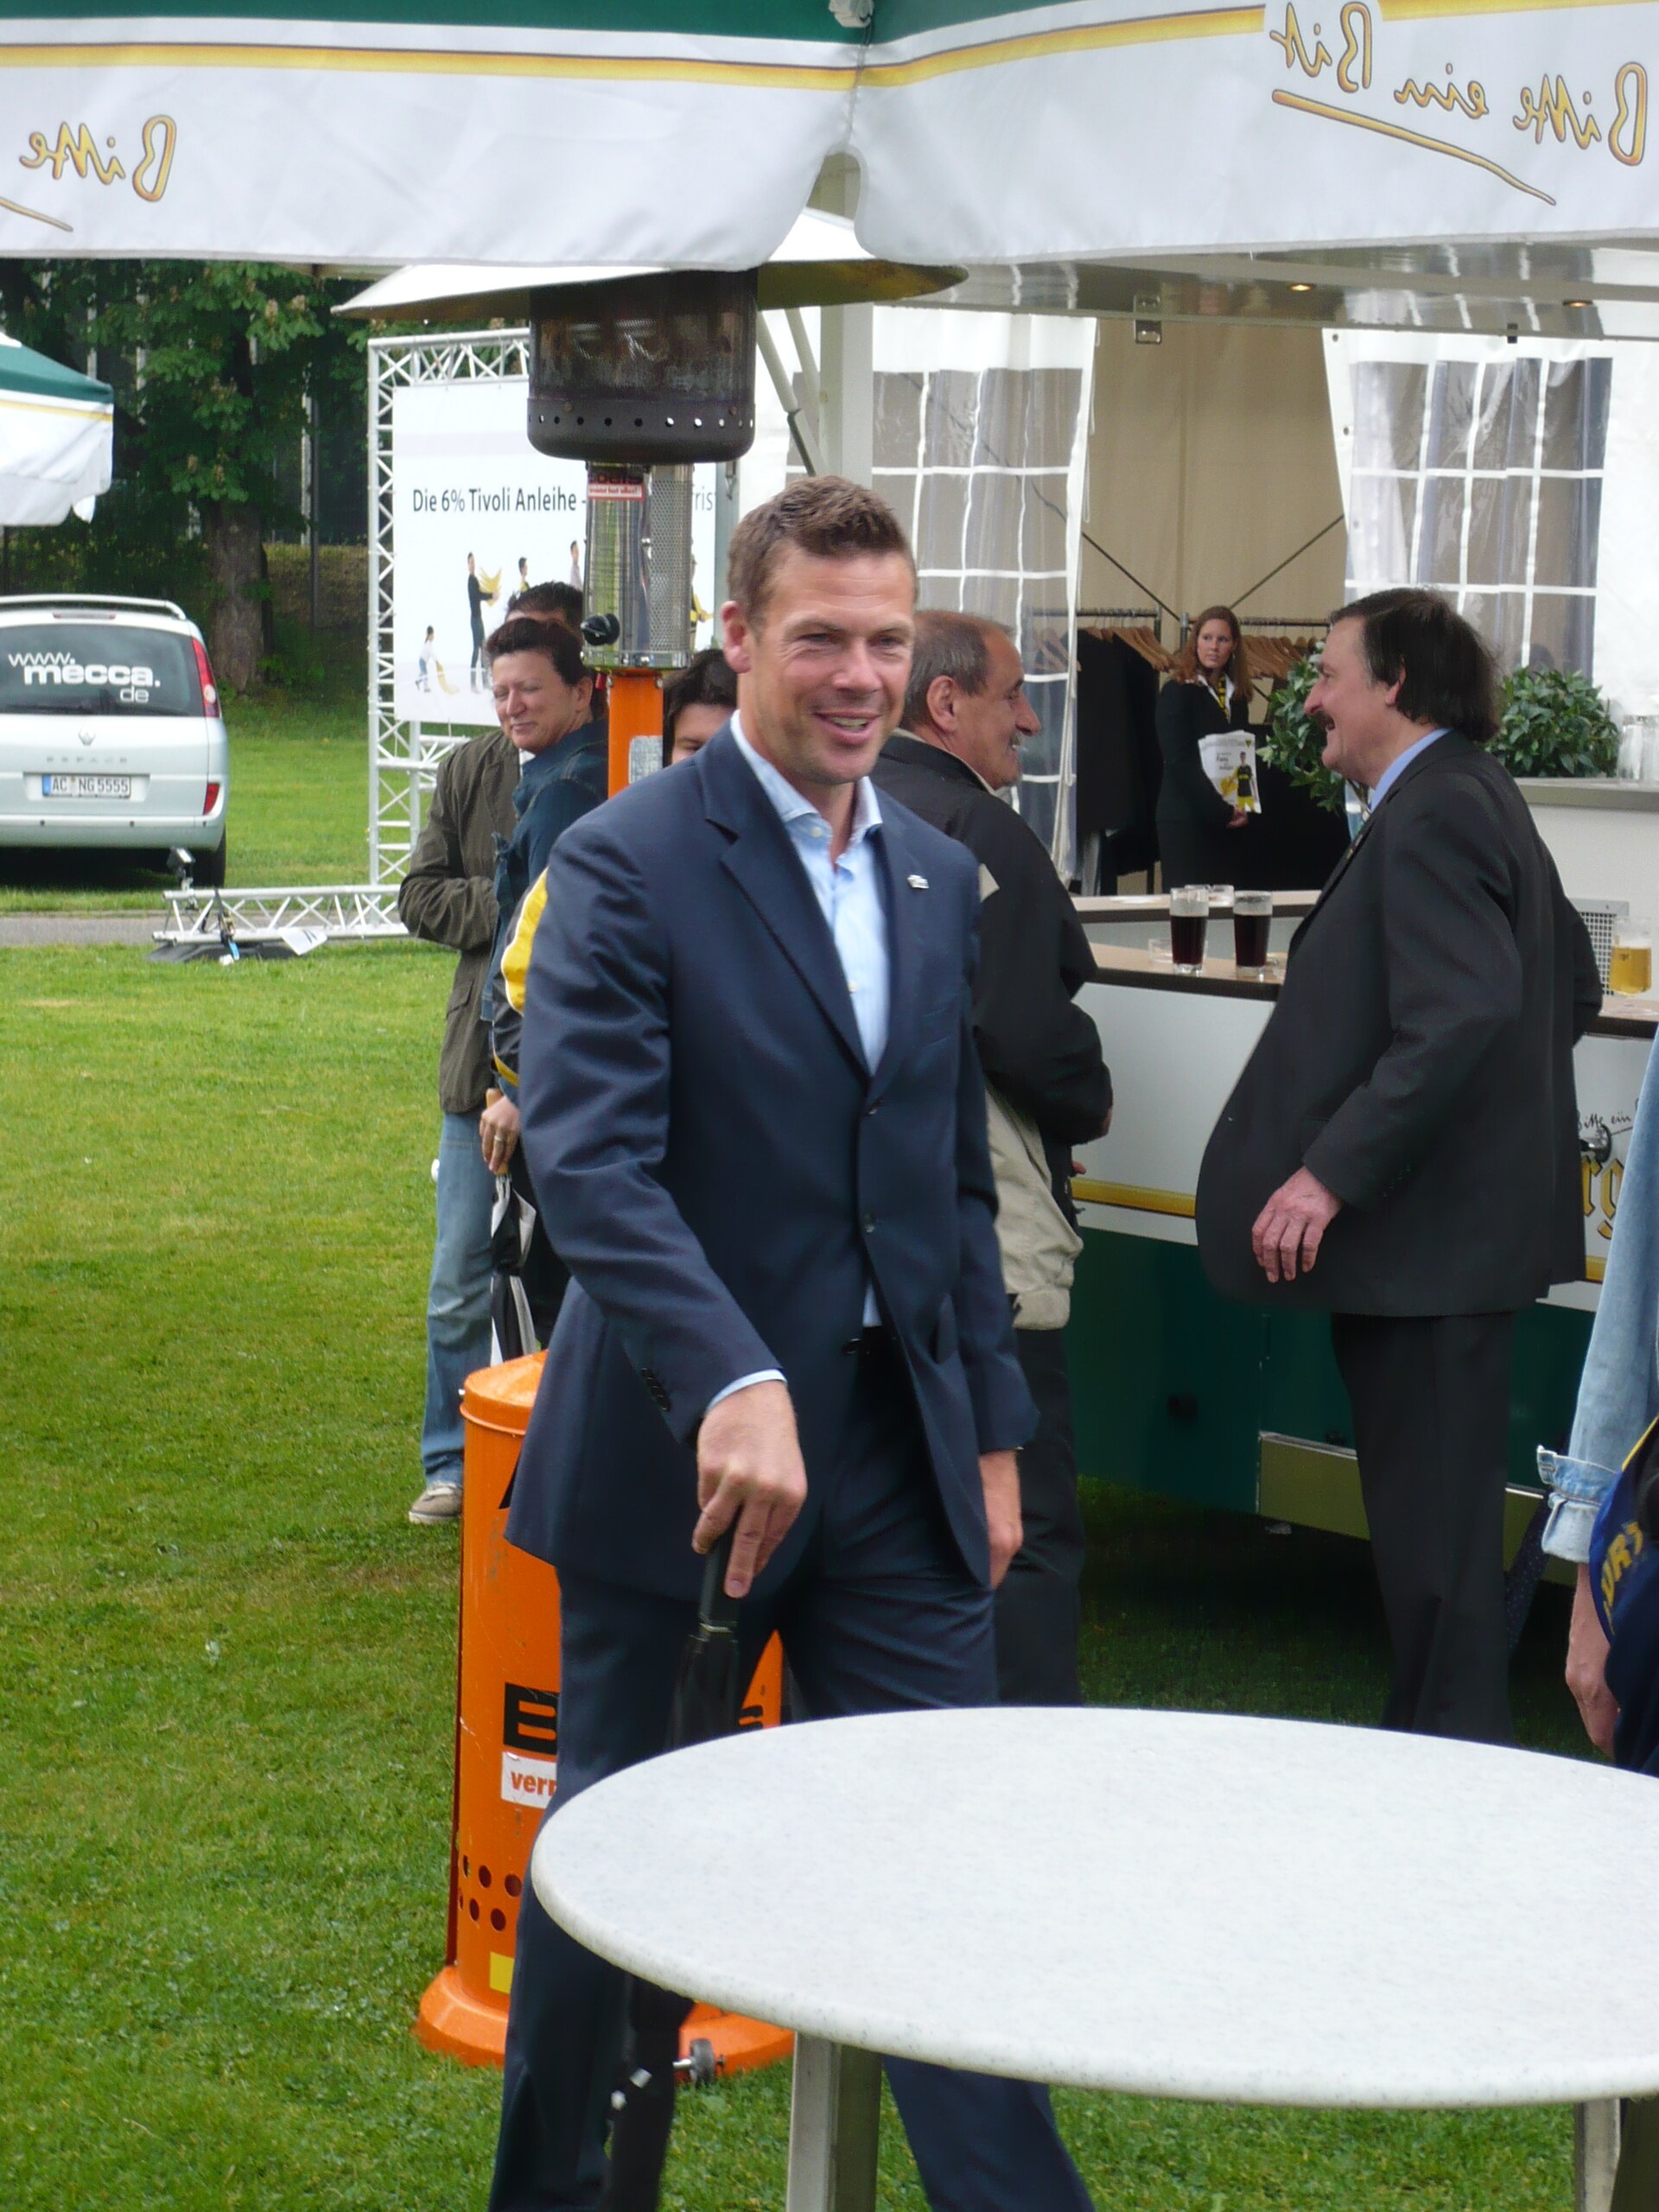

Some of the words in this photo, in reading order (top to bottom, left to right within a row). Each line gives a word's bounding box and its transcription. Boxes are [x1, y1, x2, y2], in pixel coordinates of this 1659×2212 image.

[412, 488, 438, 512] Die
[441, 488, 466, 512] 6%
[467, 486, 511, 512] Tivoli
[515, 486, 577, 512] Anleihe
[8, 652, 76, 668] www.
[23, 663, 162, 688] mecca.
[119, 685, 149, 703] de
[52, 777, 67, 791] AC
[79, 778, 95, 792] NG
[97, 778, 129, 793] 5555
